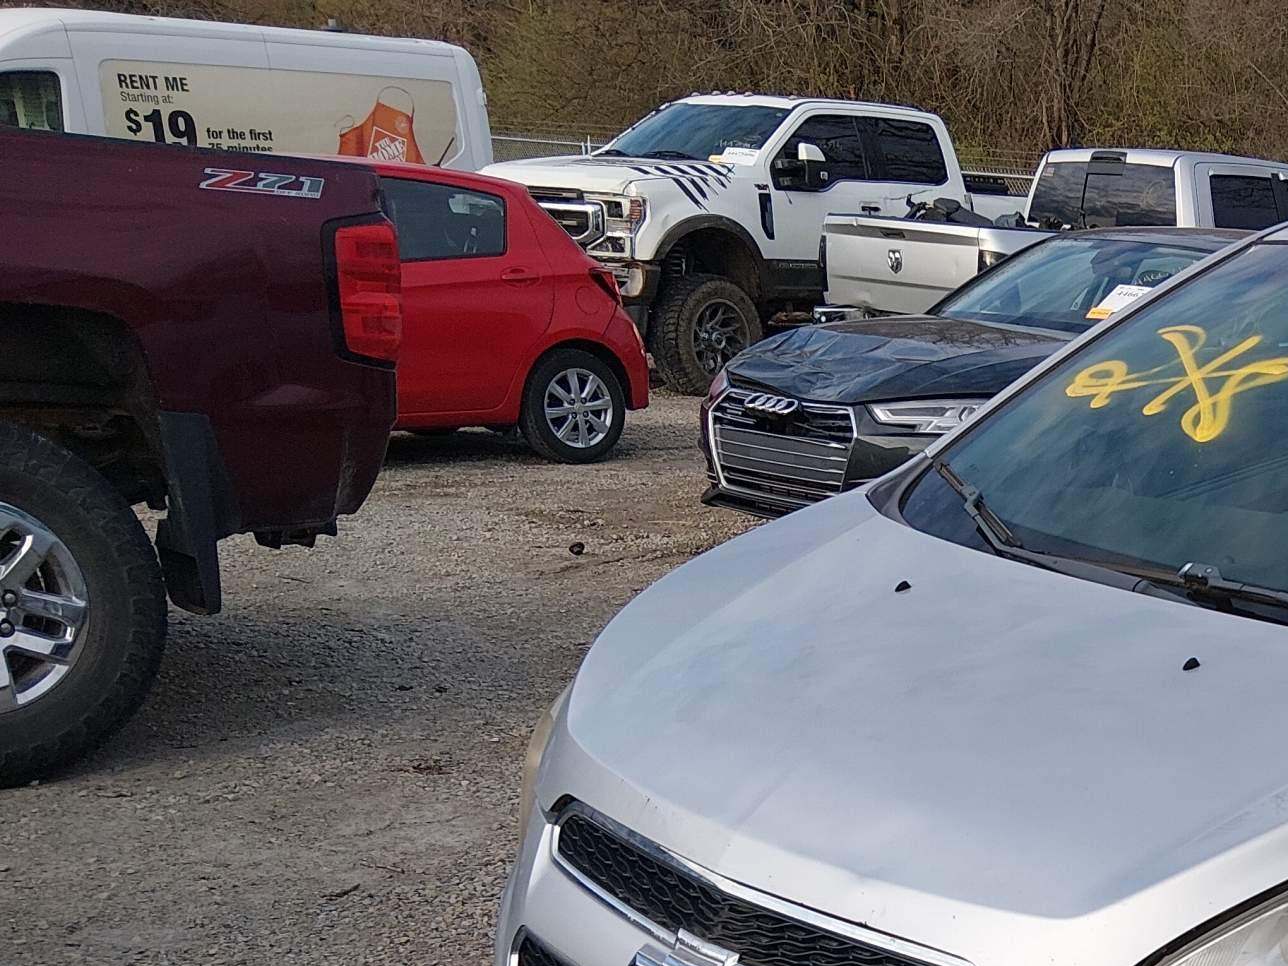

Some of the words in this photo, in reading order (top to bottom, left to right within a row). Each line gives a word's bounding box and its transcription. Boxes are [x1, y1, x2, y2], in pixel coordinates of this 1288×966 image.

[117, 73, 159, 91] RENT
[165, 77, 190, 92] ME
[120, 91, 159, 105] Starting
[124, 107, 198, 147] $19
[206, 127, 223, 140] for
[227, 128, 246, 141] the
[249, 129, 273, 142] first
[199, 167, 325, 199] Z71
